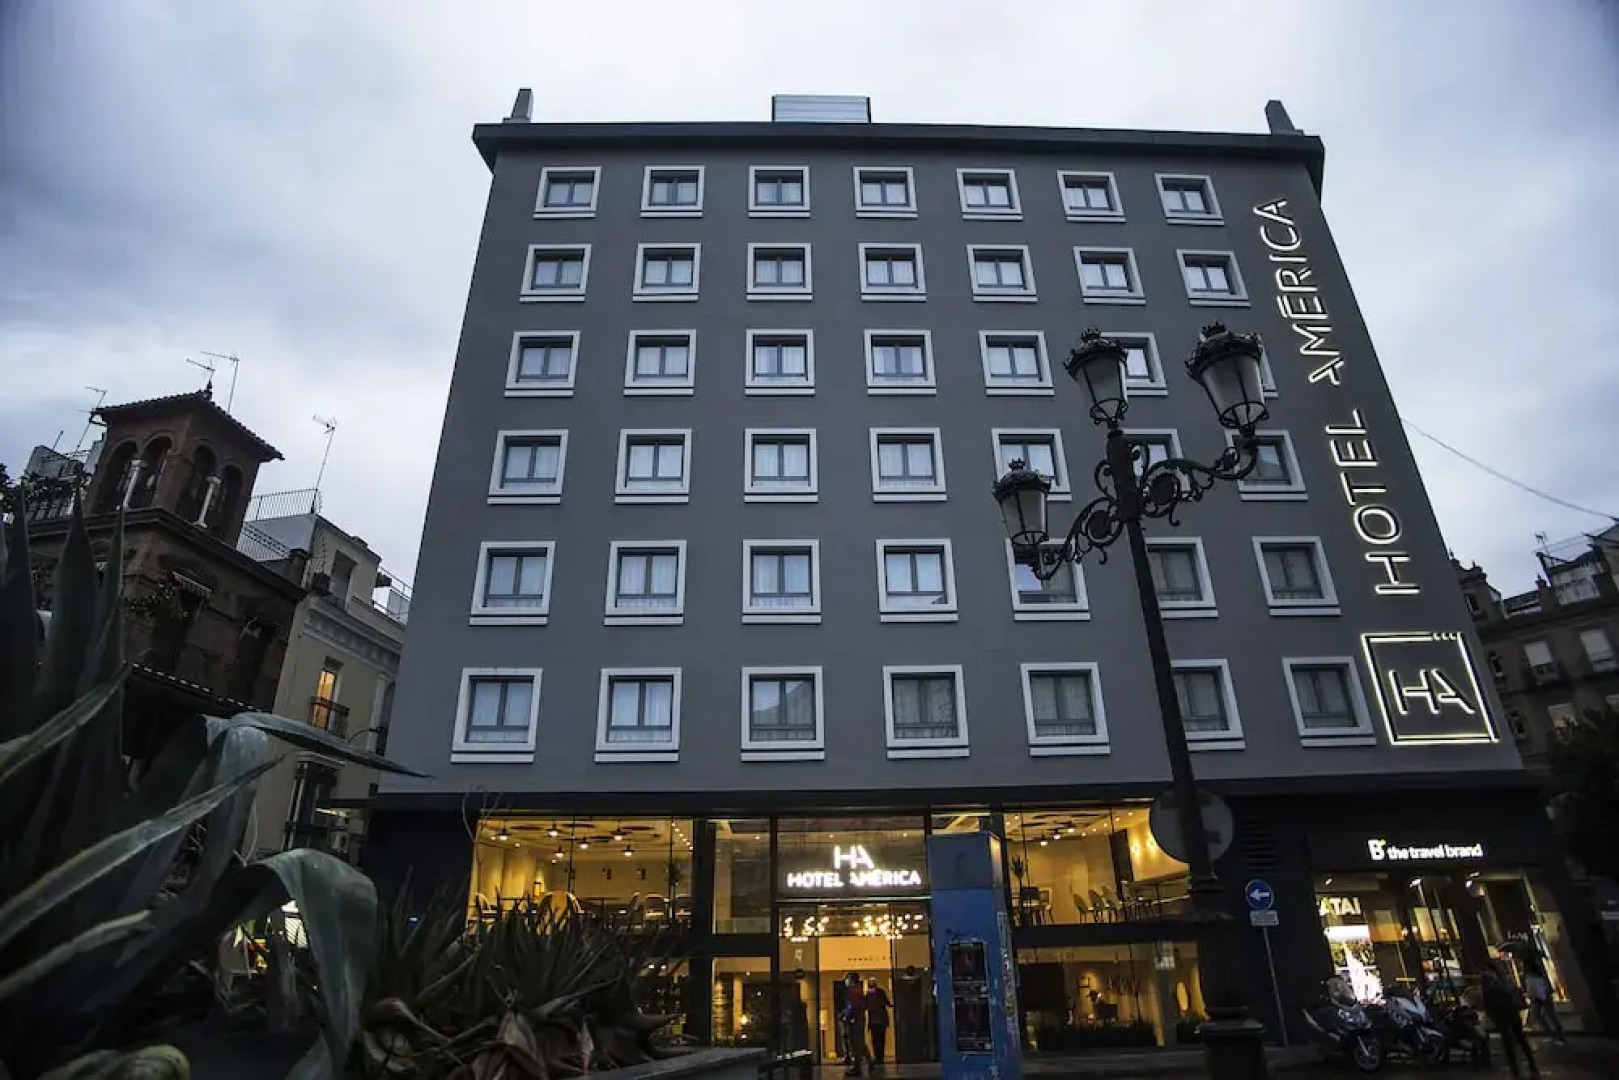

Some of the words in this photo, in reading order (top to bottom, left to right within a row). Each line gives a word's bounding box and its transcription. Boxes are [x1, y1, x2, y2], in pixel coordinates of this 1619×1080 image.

[1253, 198, 1345, 386] AMÉRICA
[1325, 408, 1420, 595] HOTEL
[1388, 668, 1476, 715] HA
[833, 844, 875, 869] HA
[1387, 845, 1409, 860] the
[1409, 844, 1444, 859] travel
[1444, 843, 1483, 858] brand
[786, 872, 844, 888] HOTEL
[1316, 896, 1362, 916] ATAI
